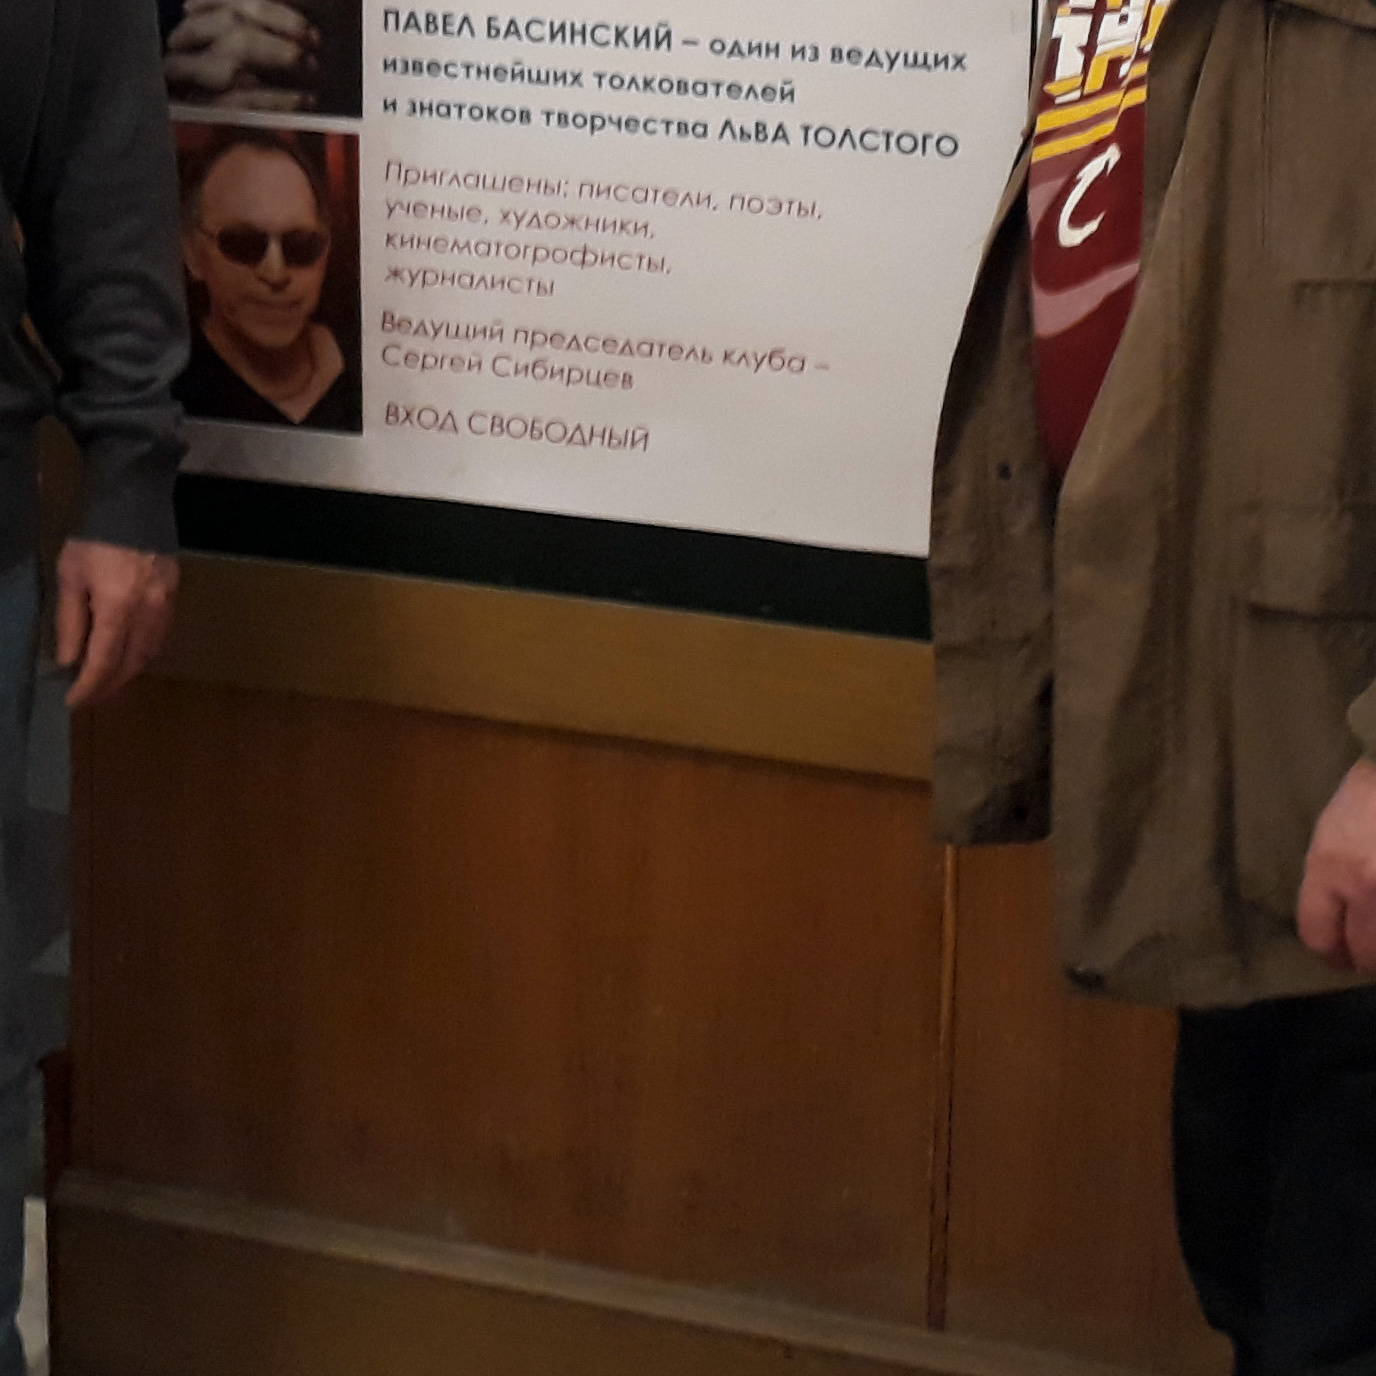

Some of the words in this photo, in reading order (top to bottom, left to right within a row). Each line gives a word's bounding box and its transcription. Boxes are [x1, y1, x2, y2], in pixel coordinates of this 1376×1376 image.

[383, 8, 475, 38] ПАВЕЛ
[486, 15, 672, 53] БАСИНСКИЙ
[709, 37, 780, 59] один
[791, 44, 819, 62] из
[830, 45, 967, 72] ведущих
[382, 56, 584, 88] известнейших
[593, 72, 795, 104] толкователей
[383, 97, 397, 116] и
[407, 98, 532, 126] знатоков
[541, 109, 709, 137] творчества
[799, 123, 959, 159] ТОЛСТОГО
[385, 199, 488, 225] ученые,
[500, 208, 655, 239] художники,
[578, 180, 717, 212] писатели,
[729, 192, 822, 220] поэты,
[384, 267, 555, 297] журналисты
[381, 309, 504, 344] Ведущий
[514, 328, 713, 364] председатель
[723, 347, 806, 374] клуба
[381, 344, 482, 372] Сергей
[492, 354, 634, 390] Сибирцев
[385, 401, 459, 434] ВХОД
[468, 410, 650, 452] СВОБОДНЫЙ
